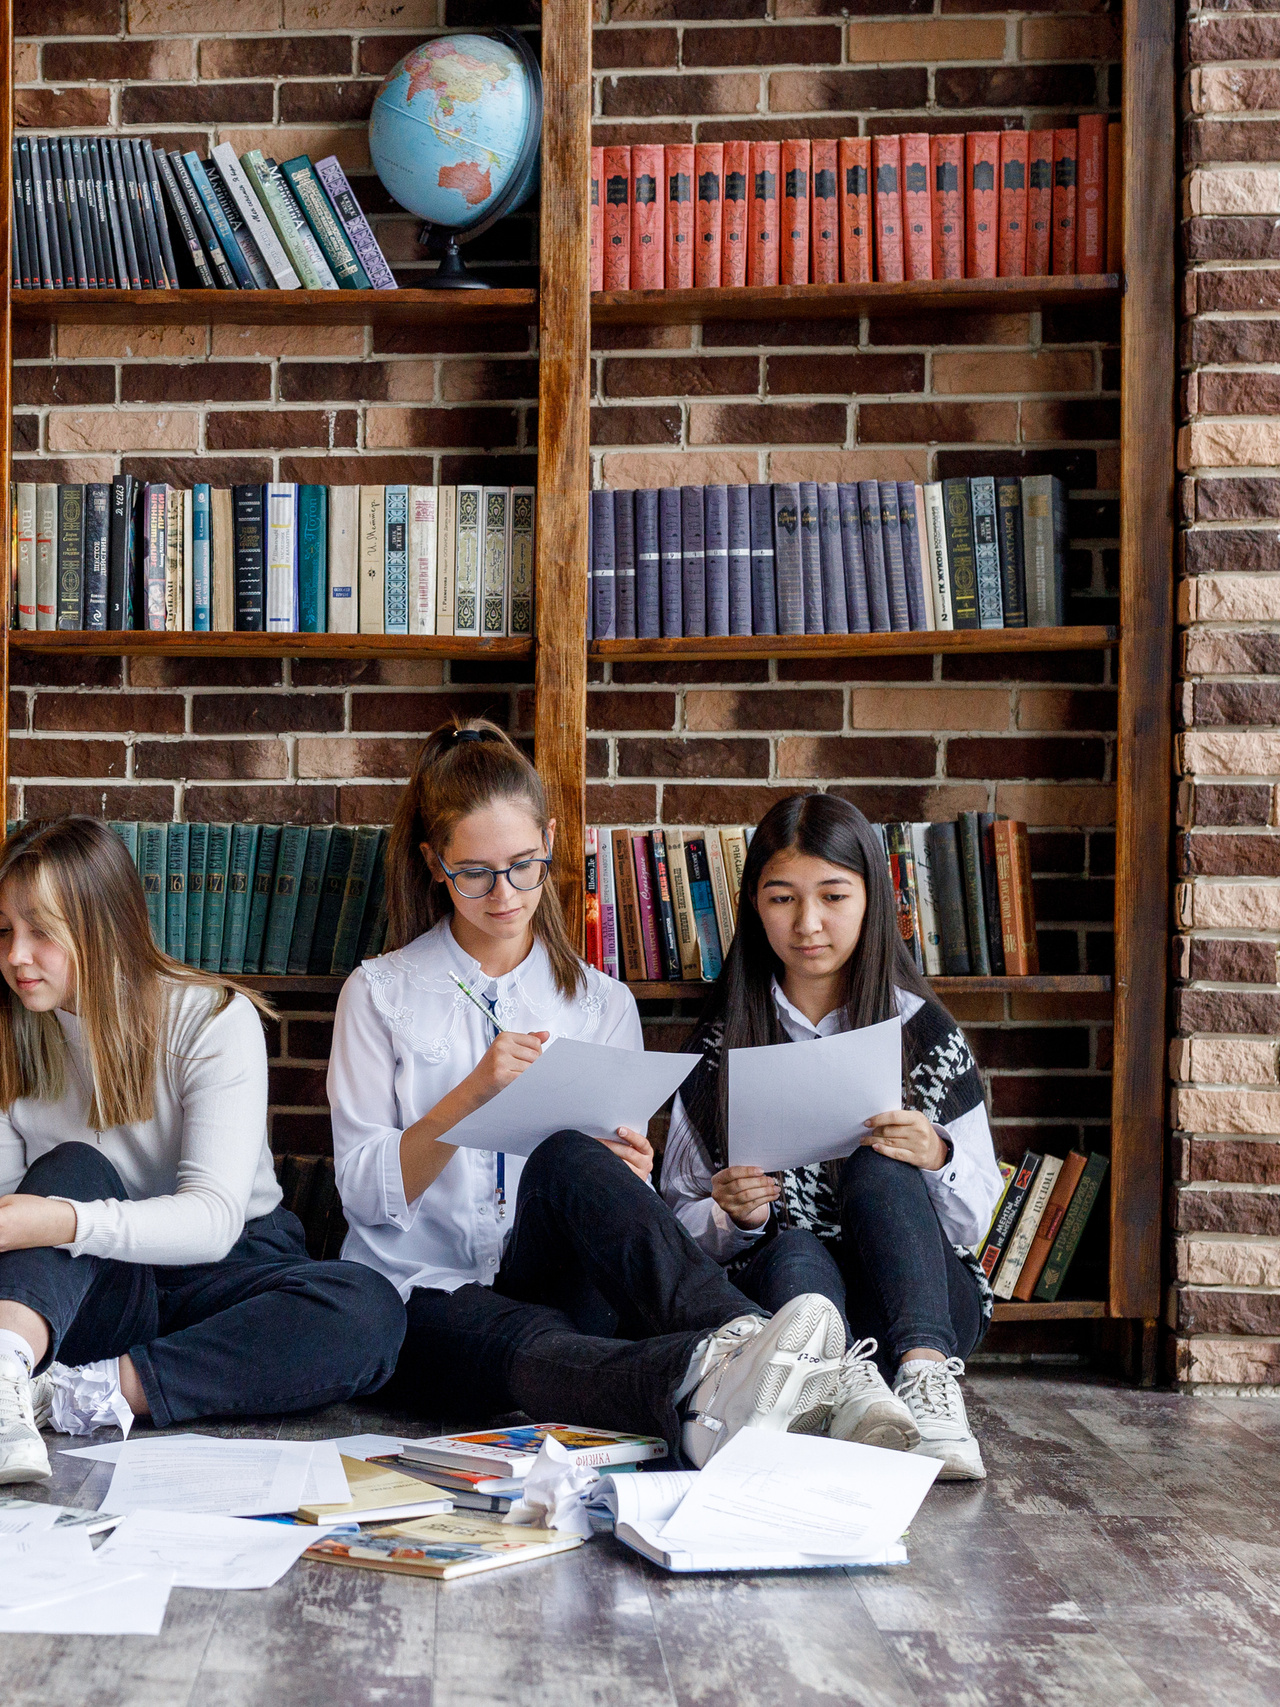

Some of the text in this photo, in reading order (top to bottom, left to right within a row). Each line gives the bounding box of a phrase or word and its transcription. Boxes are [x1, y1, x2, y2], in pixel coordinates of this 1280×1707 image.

[174, 156, 202, 214] БРАТСТВО КРЕСТА
[18, 510, 34, 544] Грин
[37, 511, 54, 546] Грин
[303, 498, 318, 543] Потоп
[936, 550, 946, 584] ЖУКОВ
[1004, 512, 1016, 608] ТАХАВИ АХТАНОВ
[941, 614, 948, 622] 2
[150, 876, 157, 888] 7
[172, 876, 182, 890] 16
[192, 876, 202, 890] 19
[208, 876, 222, 890] 17
[233, 876, 246, 890] 15
[258, 876, 269, 890] 14
[282, 878, 290, 890] 5
[588, 868, 596, 890] Шобха
[660, 876, 671, 902] ДИКИЙ
[606, 906, 616, 954] ПОЛЯНСКАЯ
[1032, 1171, 1056, 1213] ЦУСИМА
[996, 1201, 1014, 1234] МЕНТЫ
[1002, 1209, 1018, 1240] АНГЕЛЫ,
[575, 1454, 611, 1466] ФИЗИКА
